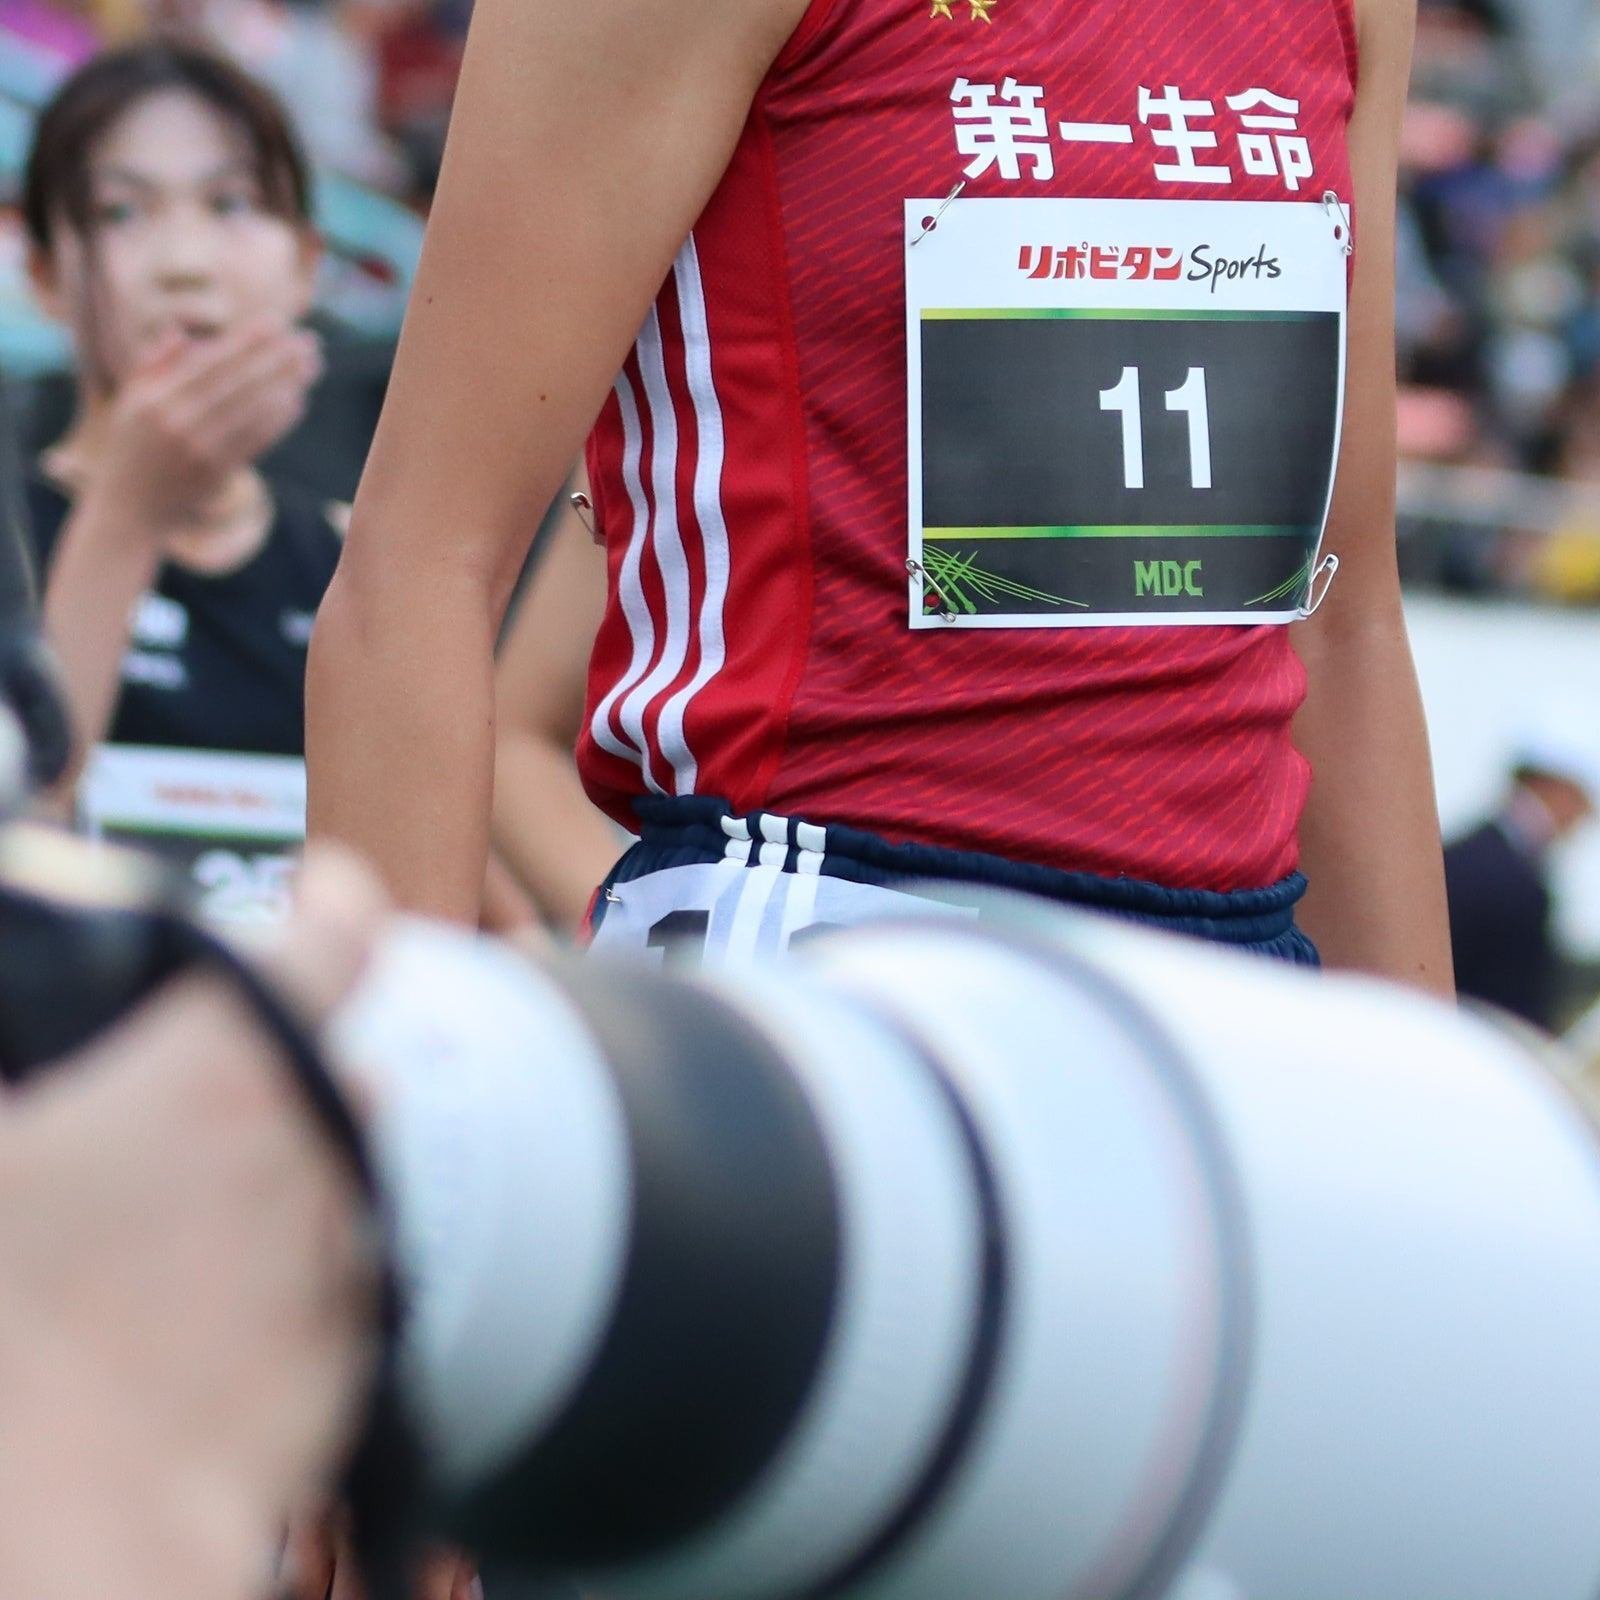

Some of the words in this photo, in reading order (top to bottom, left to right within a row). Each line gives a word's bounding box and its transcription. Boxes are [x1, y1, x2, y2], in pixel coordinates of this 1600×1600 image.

[949, 76, 1314, 191] 第一生命
[1017, 242, 1183, 281] リポビタン
[1187, 244, 1283, 293] Sports
[1099, 366, 1212, 489] 11
[1134, 559, 1204, 597] MDC
